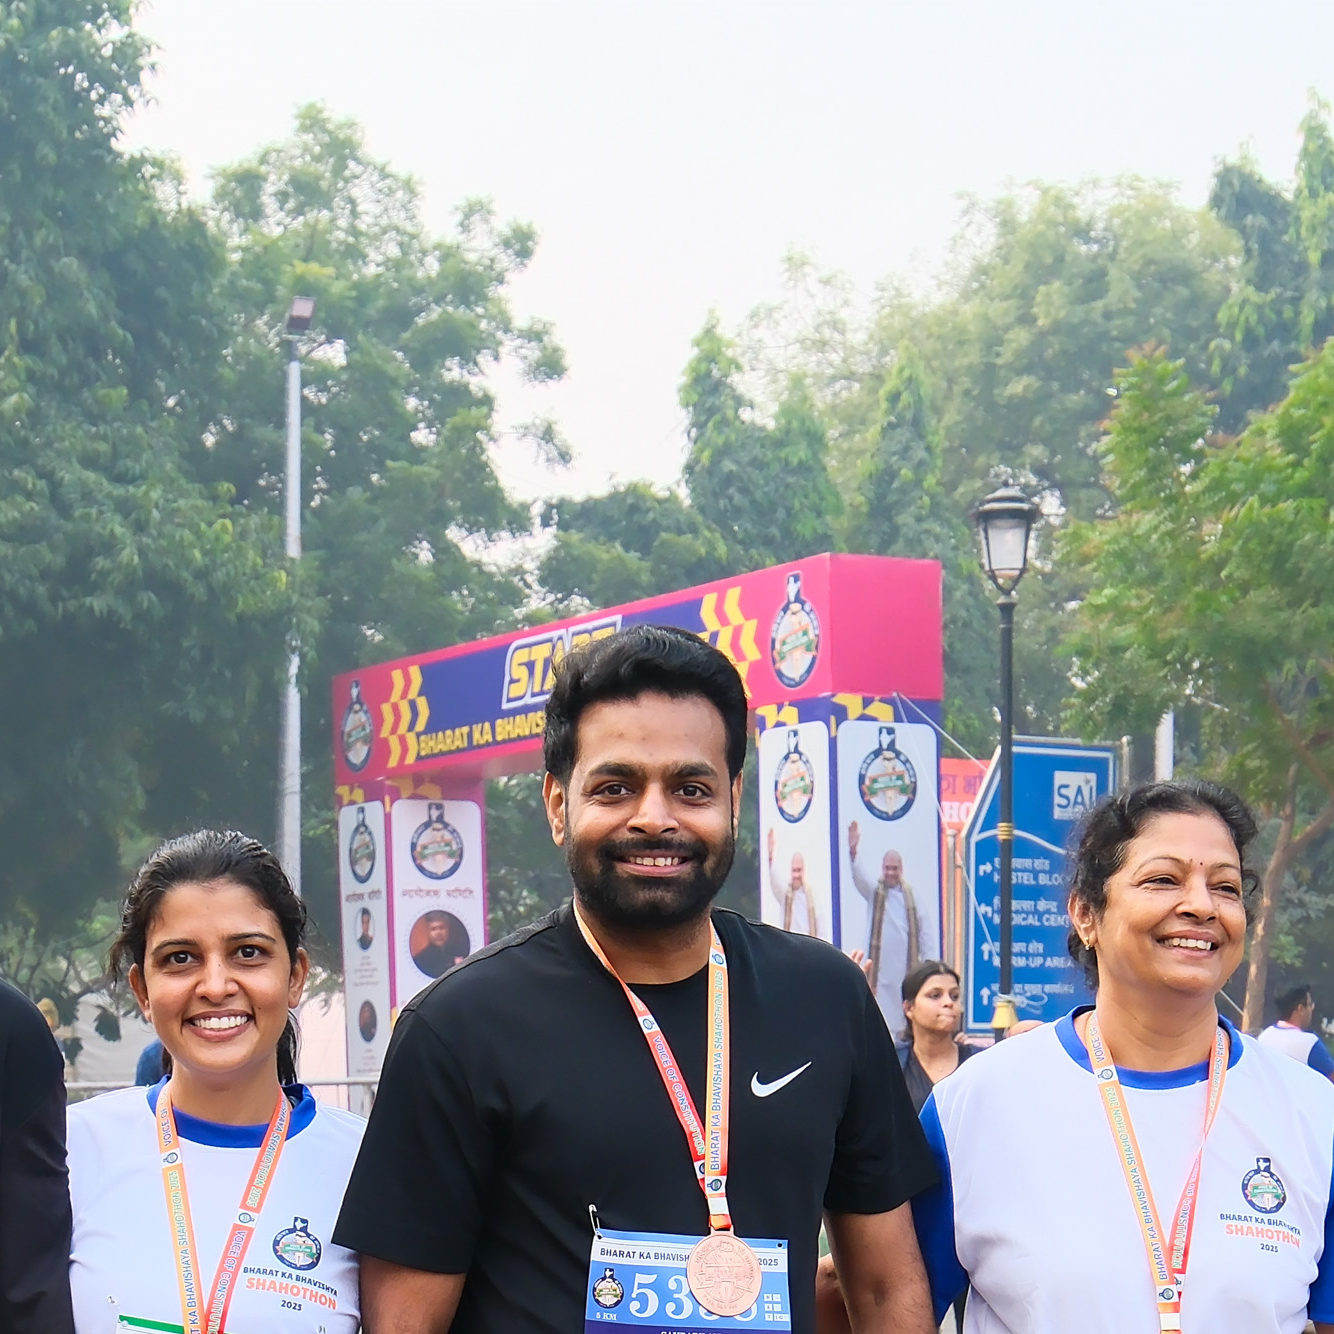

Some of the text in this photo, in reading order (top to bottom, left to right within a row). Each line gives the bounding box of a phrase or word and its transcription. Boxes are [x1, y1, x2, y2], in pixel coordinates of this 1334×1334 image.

[508, 626, 615, 698] STA
[418, 726, 470, 756] BHARAT
[472, 721, 493, 746] KA
[993, 871, 1037, 885] HSTEL
[992, 912, 1041, 927] MDICAL
[1094, 1037, 1105, 1063] VOICE
[711, 1051, 724, 1112] BHAVISHAYA
[653, 1036, 706, 1156] VOICE OF CONSTITUTION
[161, 1117, 172, 1147] VOICE
[711, 1112, 720, 1128] KA
[709, 1129, 720, 1171] BHARAT
[1129, 1166, 1154, 1224] BHAVISHAYA
[170, 1190, 190, 1247] SHAHOTHON
[1219, 1213, 1253, 1222] BHARAT
[1254, 1216, 1266, 1225] KA
[229, 1230, 248, 1258] VOICE
[1145, 1224, 1158, 1241] KA
[1225, 1223, 1300, 1249] SHAHOTHON
[599, 1247, 637, 1259] BHARAT
[638, 1252, 651, 1260] KA
[758, 1257, 779, 1267] 2025
[1151, 1241, 1168, 1281] BHARAT
[1260, 1243, 1279, 1253] 2025
[177, 1247, 197, 1309] BHAVISHAYA
[226, 1258, 237, 1273] OF
[242, 1266, 338, 1297] BHARAT KA BHAVISHYA
[245, 1277, 337, 1311] SHAHOTHON
[188, 1309, 200, 1327] KA
[280, 1299, 303, 1312] 2025
[602, 1312, 617, 1321] KM
